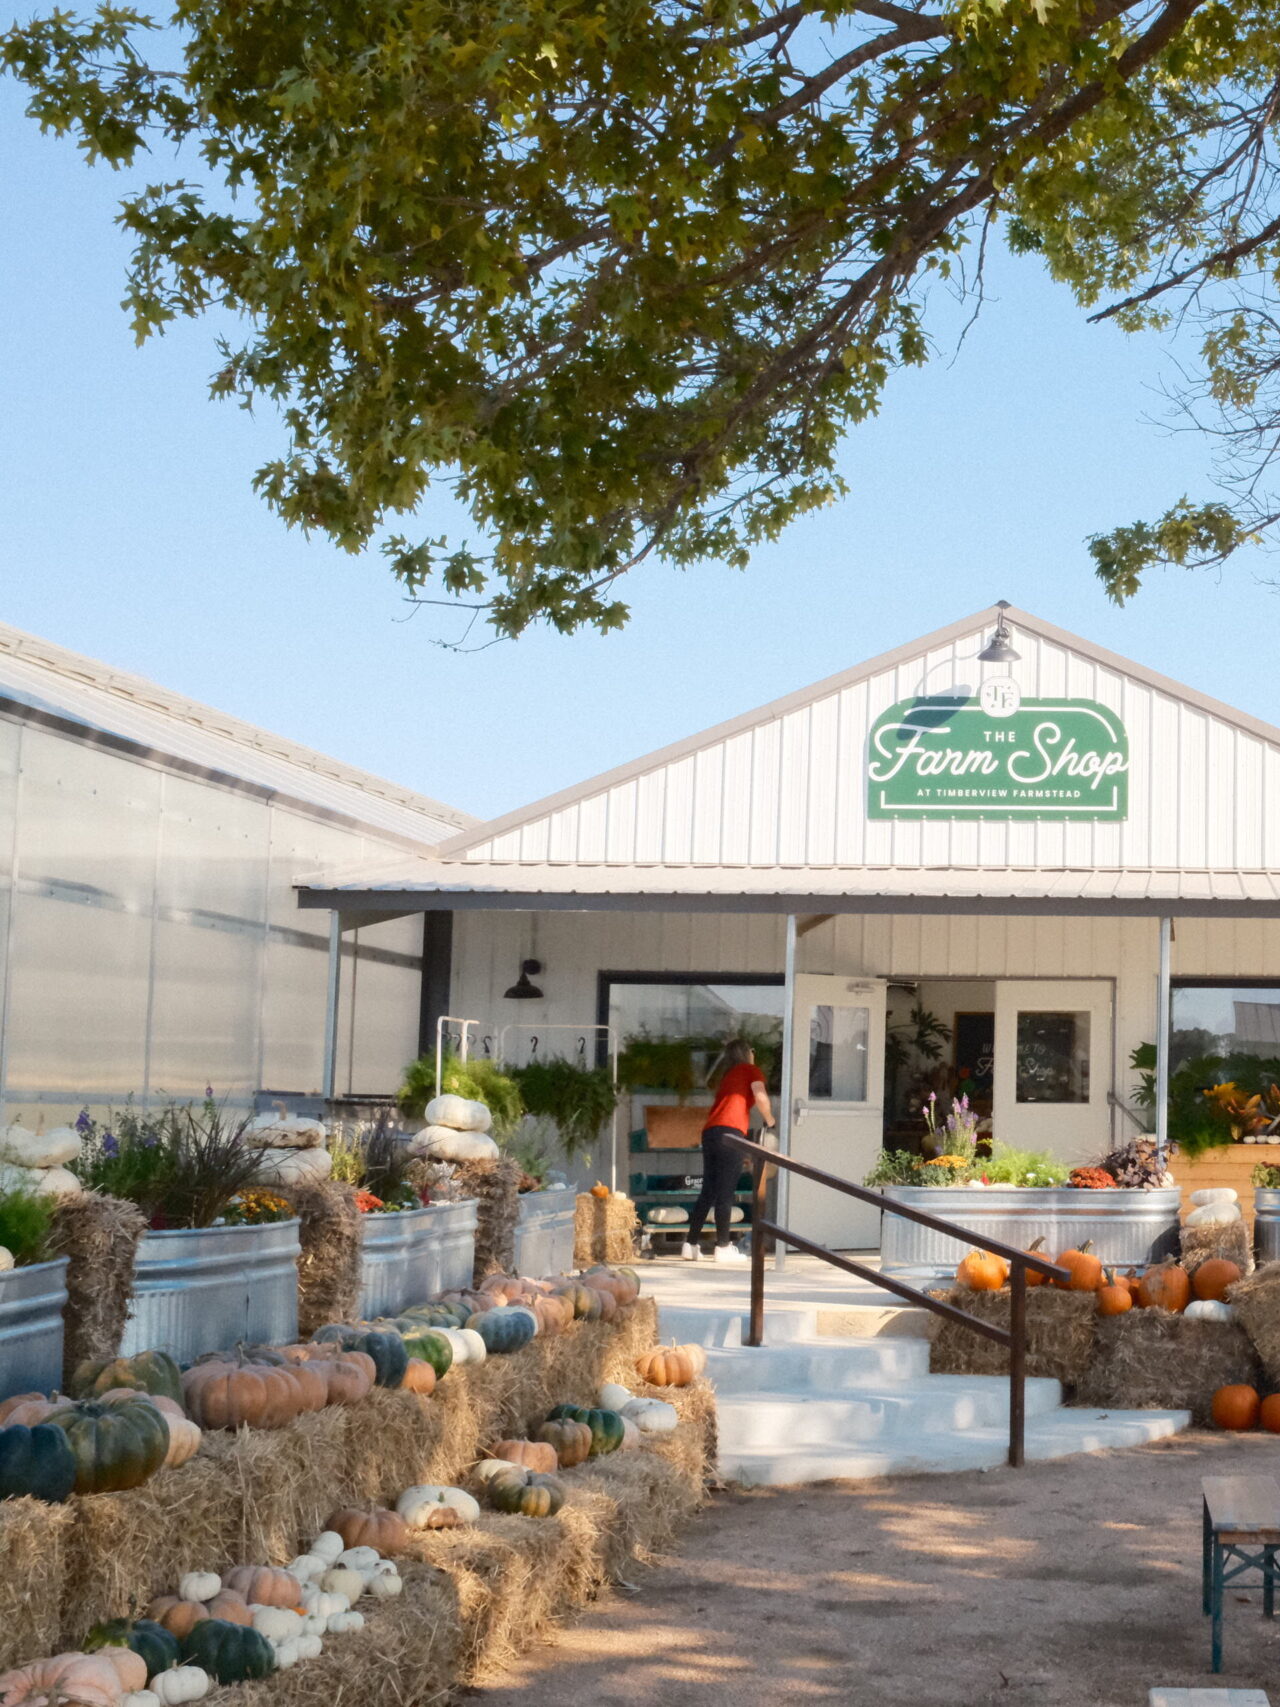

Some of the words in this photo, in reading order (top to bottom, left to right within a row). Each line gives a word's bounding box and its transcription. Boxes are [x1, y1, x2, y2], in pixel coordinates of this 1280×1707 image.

[984, 731, 1016, 742] THE
[869, 723, 999, 782] Farm
[1008, 722, 1130, 790] Shop
[916, 789, 931, 797] AT
[936, 789, 1008, 798] TIMBERVIEW
[1013, 789, 1081, 799] FARMSTEAD
